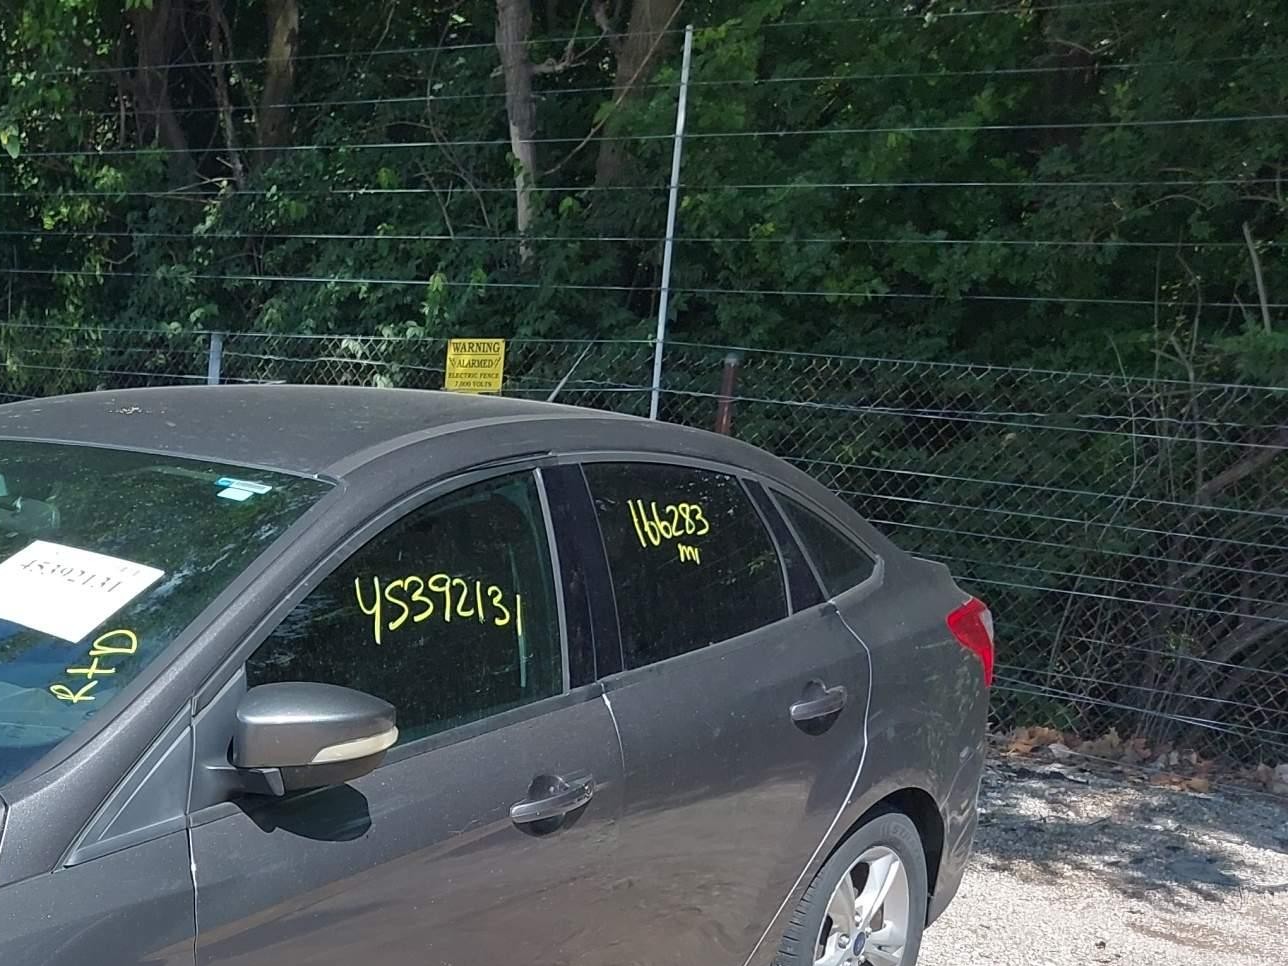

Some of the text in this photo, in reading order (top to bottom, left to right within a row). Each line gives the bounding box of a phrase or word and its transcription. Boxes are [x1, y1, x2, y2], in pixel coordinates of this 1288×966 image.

[452, 342, 500, 352] WARNING
[457, 359, 493, 368] ALARMED
[627, 499, 709, 548] 166283
[354, 573, 522, 645] 45392131
